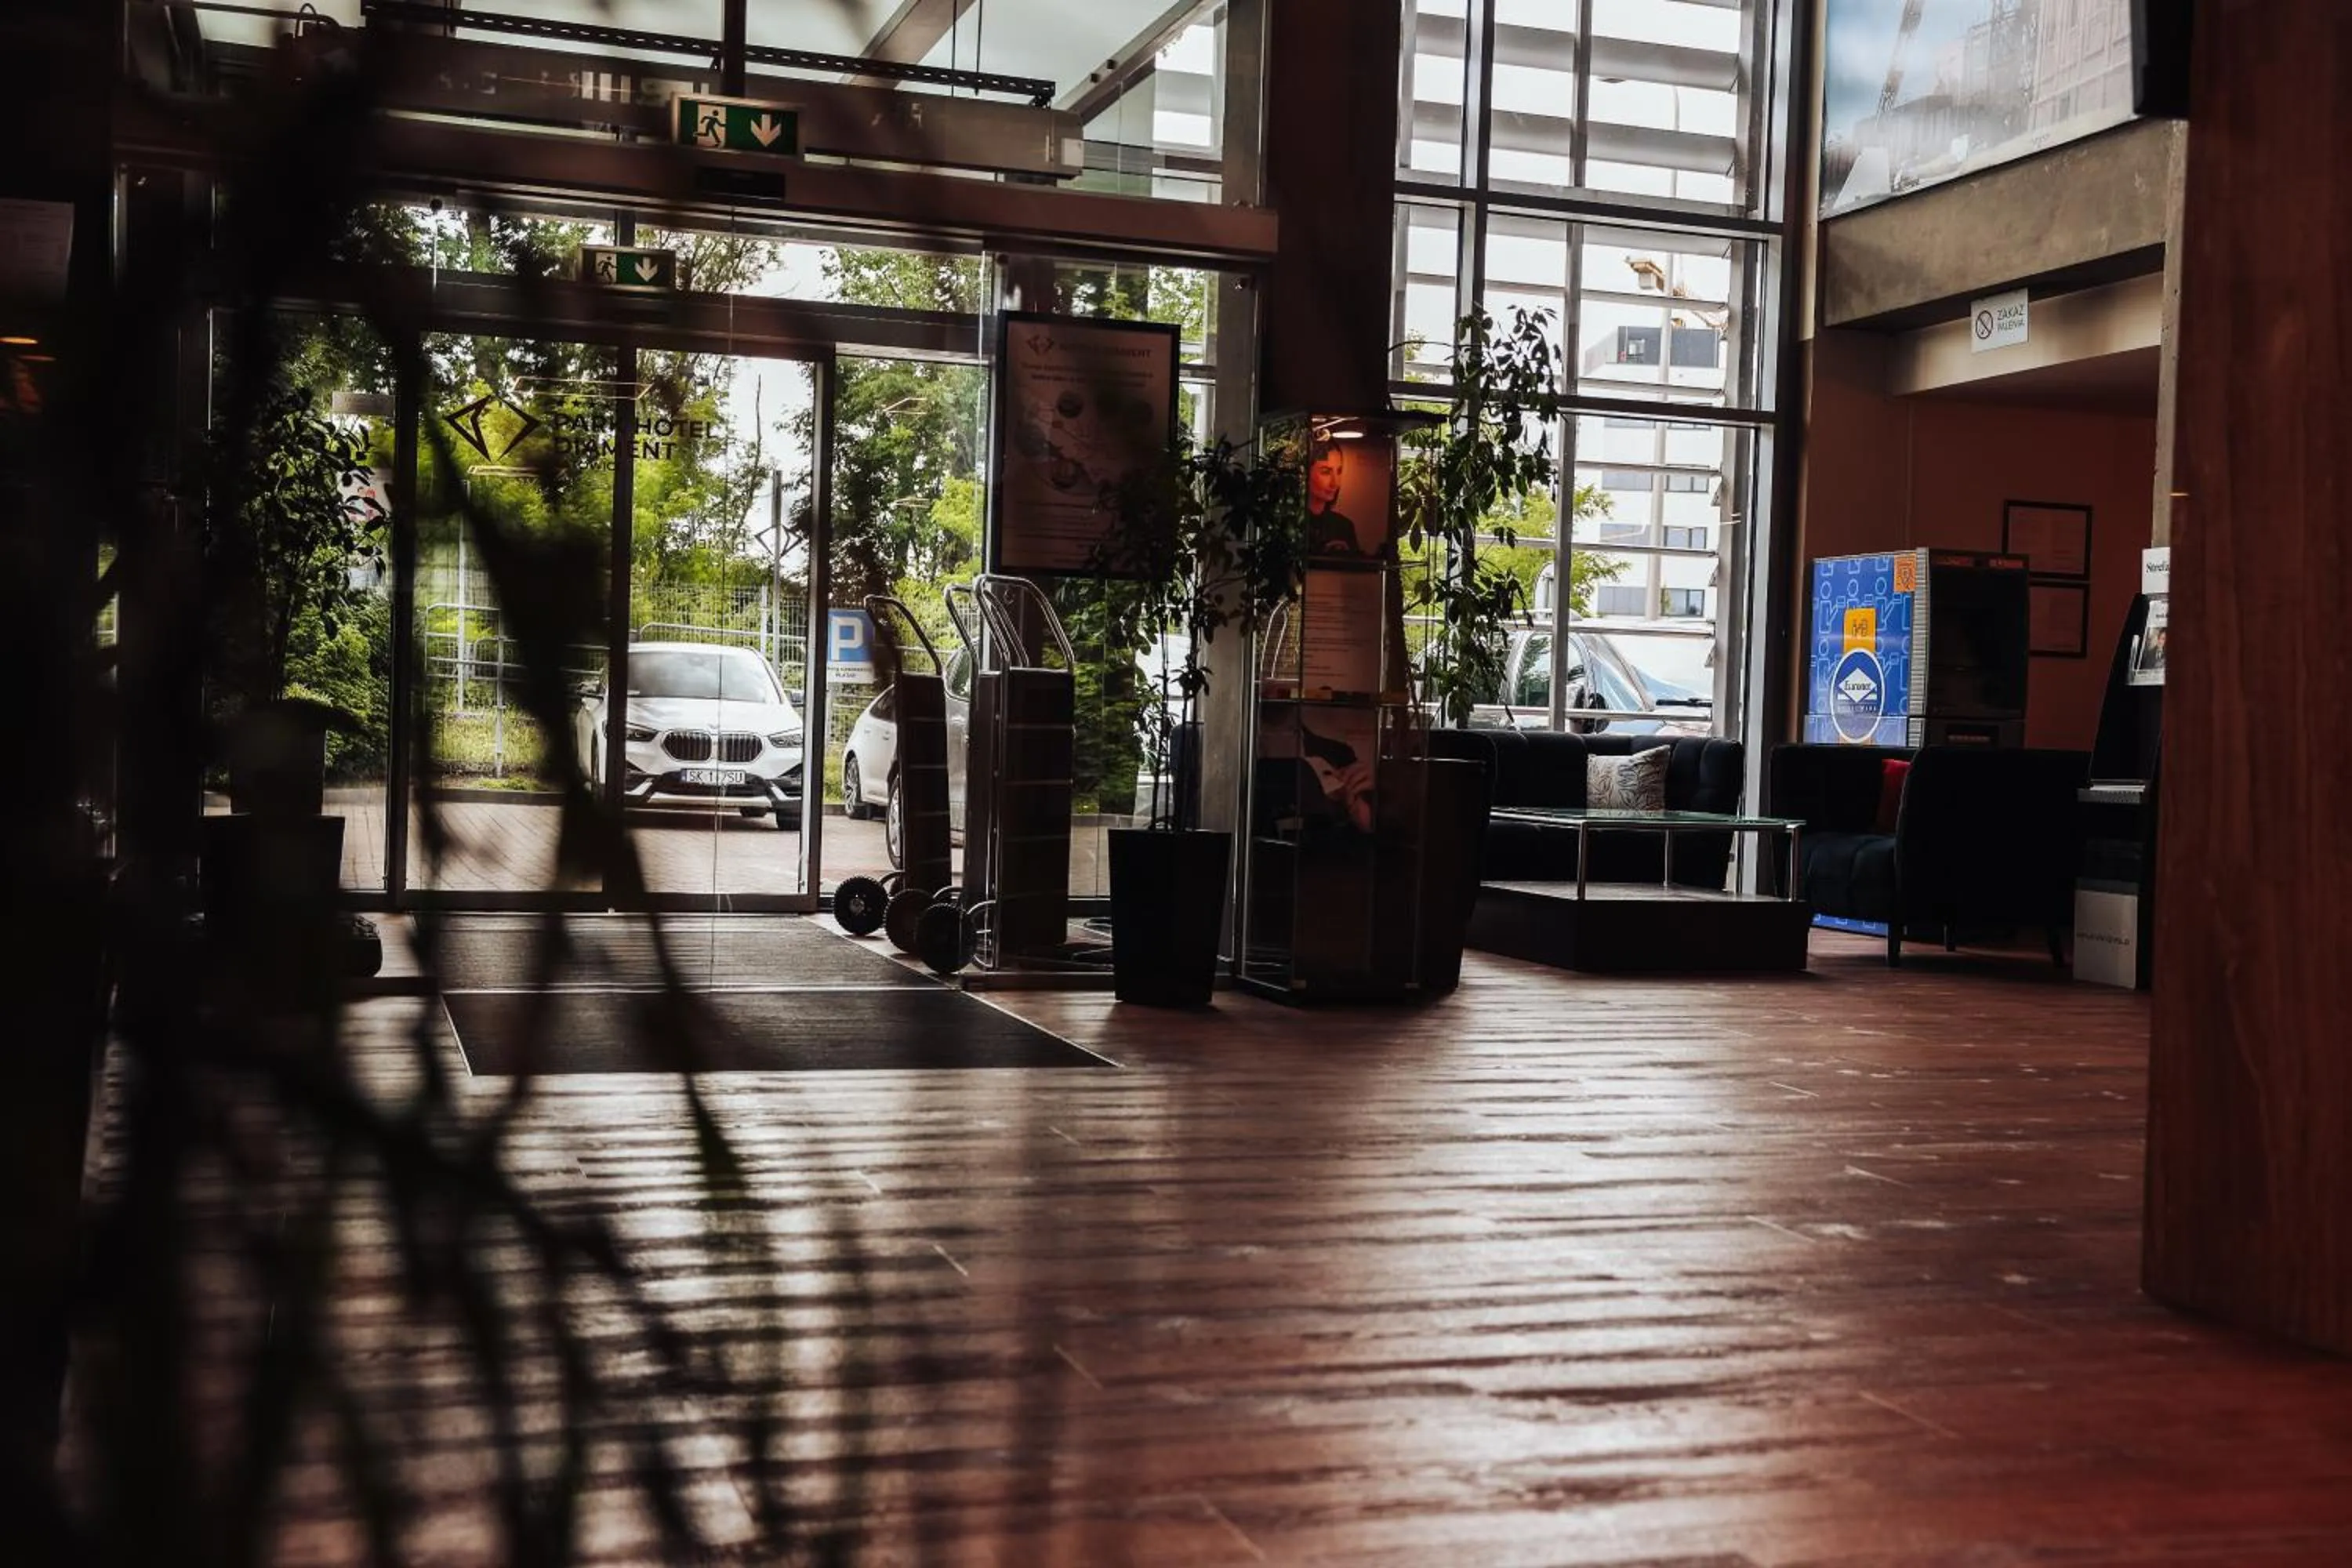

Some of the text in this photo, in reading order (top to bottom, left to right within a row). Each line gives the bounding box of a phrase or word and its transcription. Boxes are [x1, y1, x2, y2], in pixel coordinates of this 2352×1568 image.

[1997, 303, 2025, 321] ZAKAZ
[636, 418, 717, 438] HOTEL
[831, 615, 863, 660] P
[690, 771, 742, 782] SK 1SU
